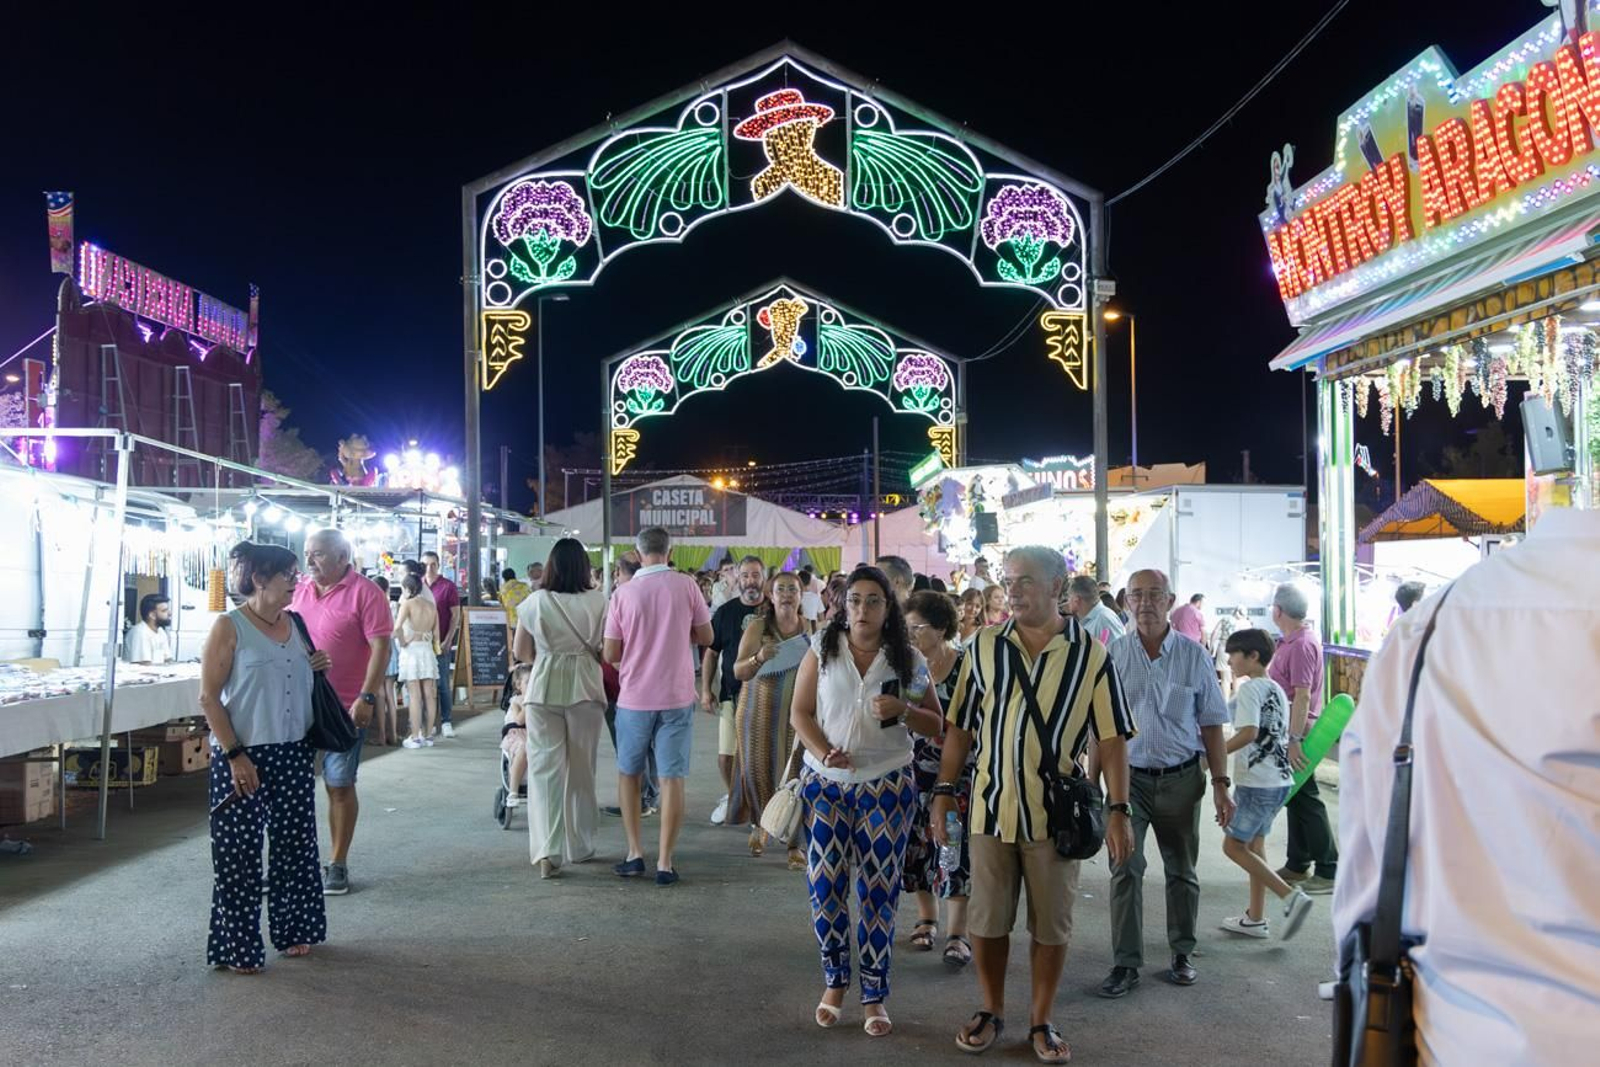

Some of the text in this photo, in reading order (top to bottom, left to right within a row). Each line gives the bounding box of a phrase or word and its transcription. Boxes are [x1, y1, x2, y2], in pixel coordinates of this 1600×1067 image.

[1268, 31, 1600, 299] MONTROY ARAGON
[652, 489, 704, 506] CASETA
[639, 509, 717, 526] MUNICIPAL
